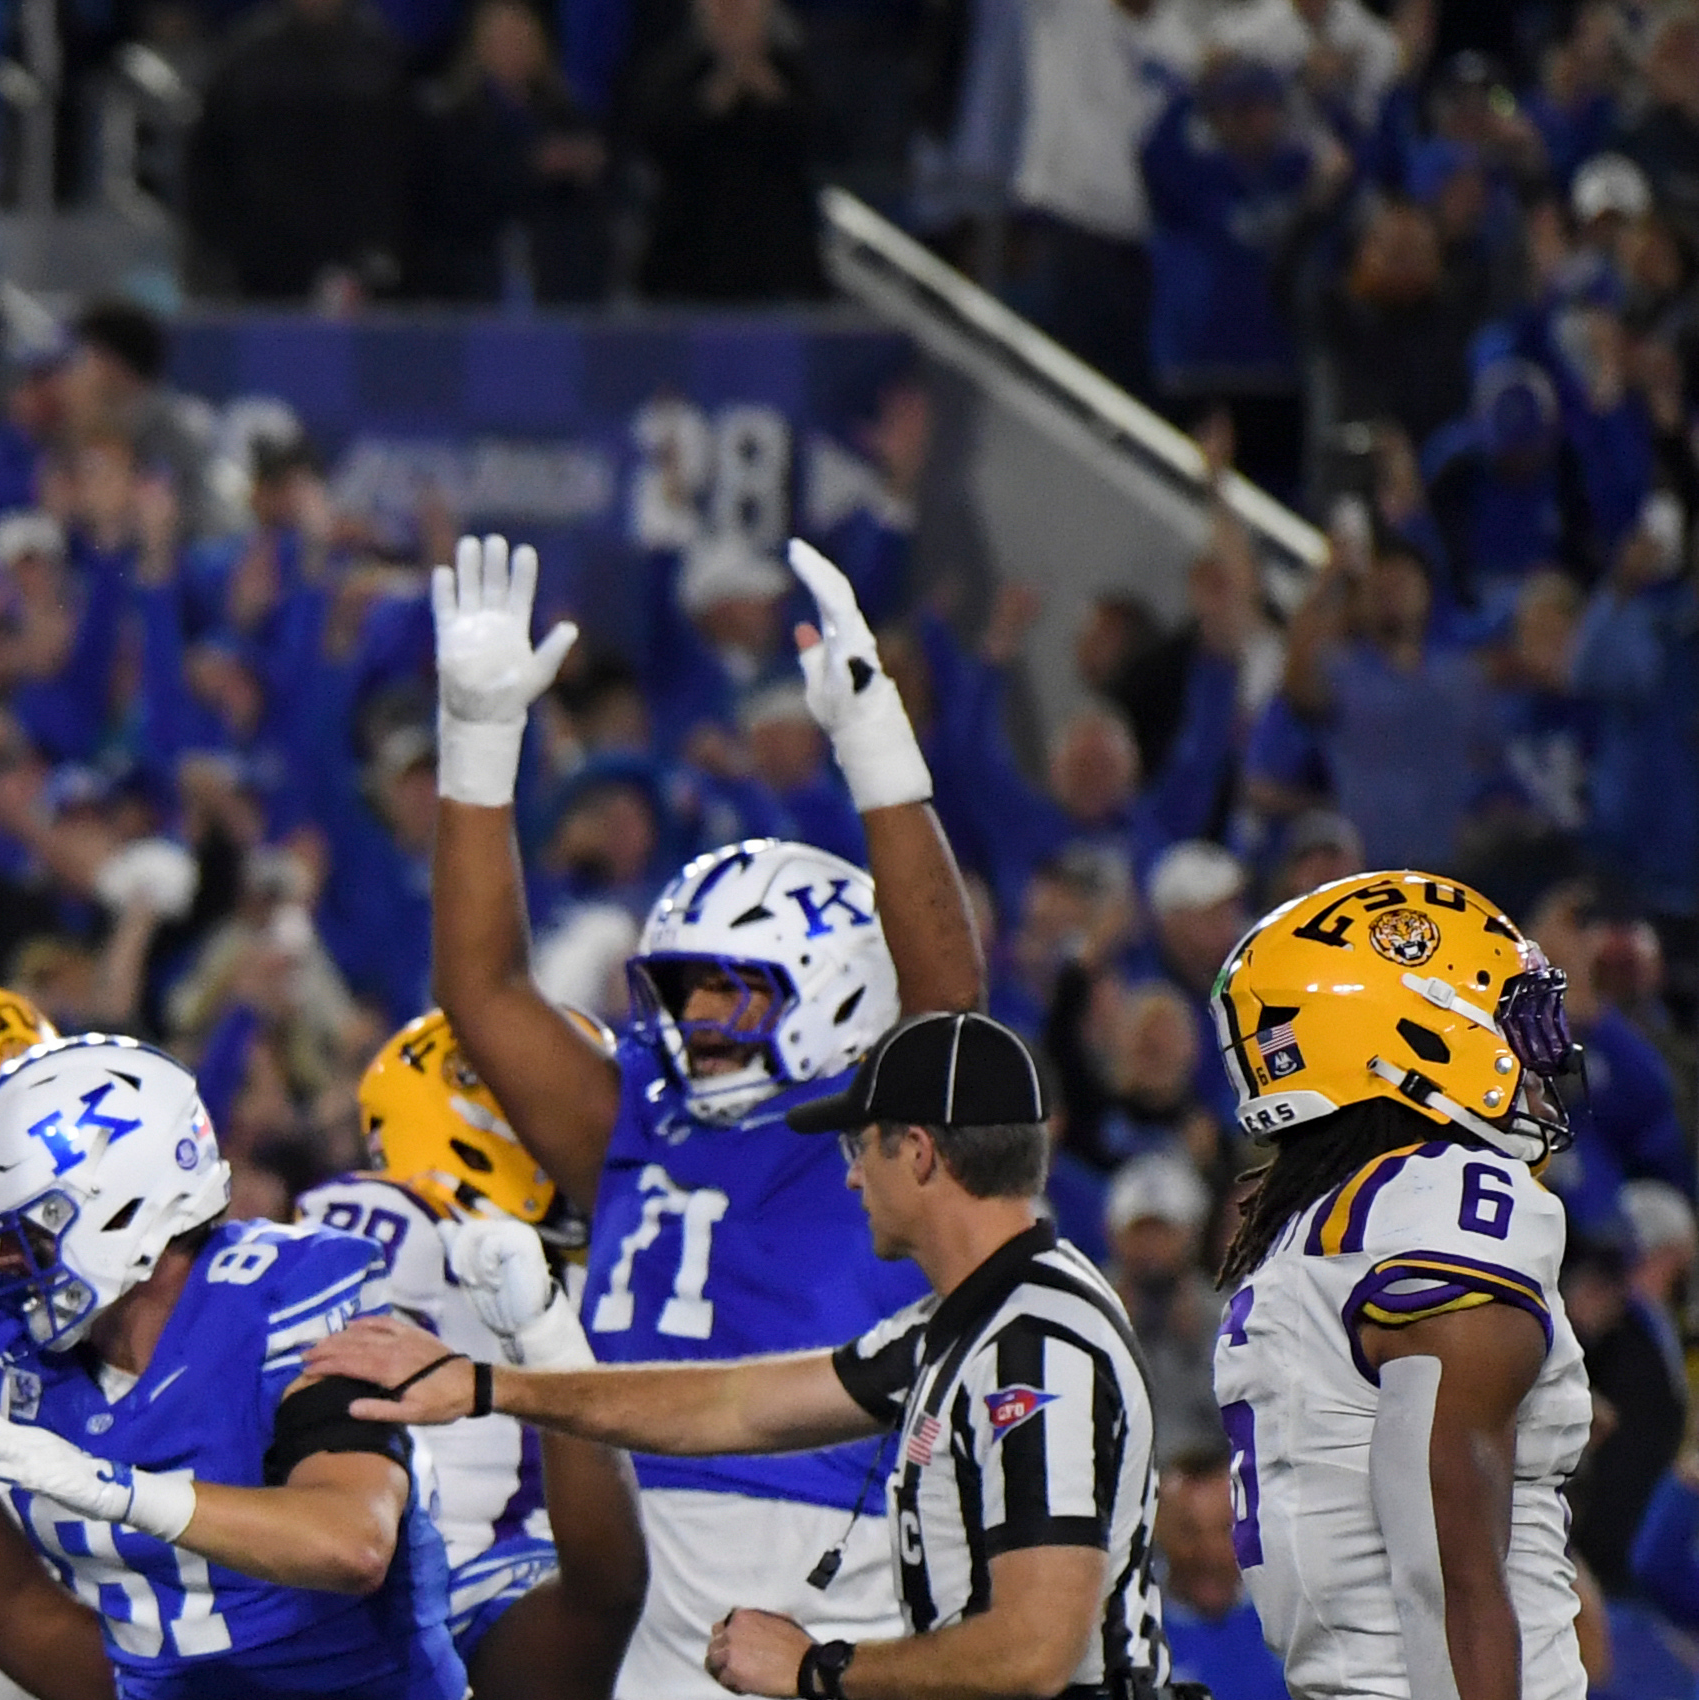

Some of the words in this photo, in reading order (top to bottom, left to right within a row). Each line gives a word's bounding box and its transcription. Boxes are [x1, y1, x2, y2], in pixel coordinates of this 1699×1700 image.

[786, 879, 874, 938] K
[1292, 881, 1467, 951] LSU
[1256, 1066, 1270, 1087] 6
[27, 1082, 144, 1177] K
[1458, 1162, 1516, 1240] 6
[900, 1510, 923, 1566] C
